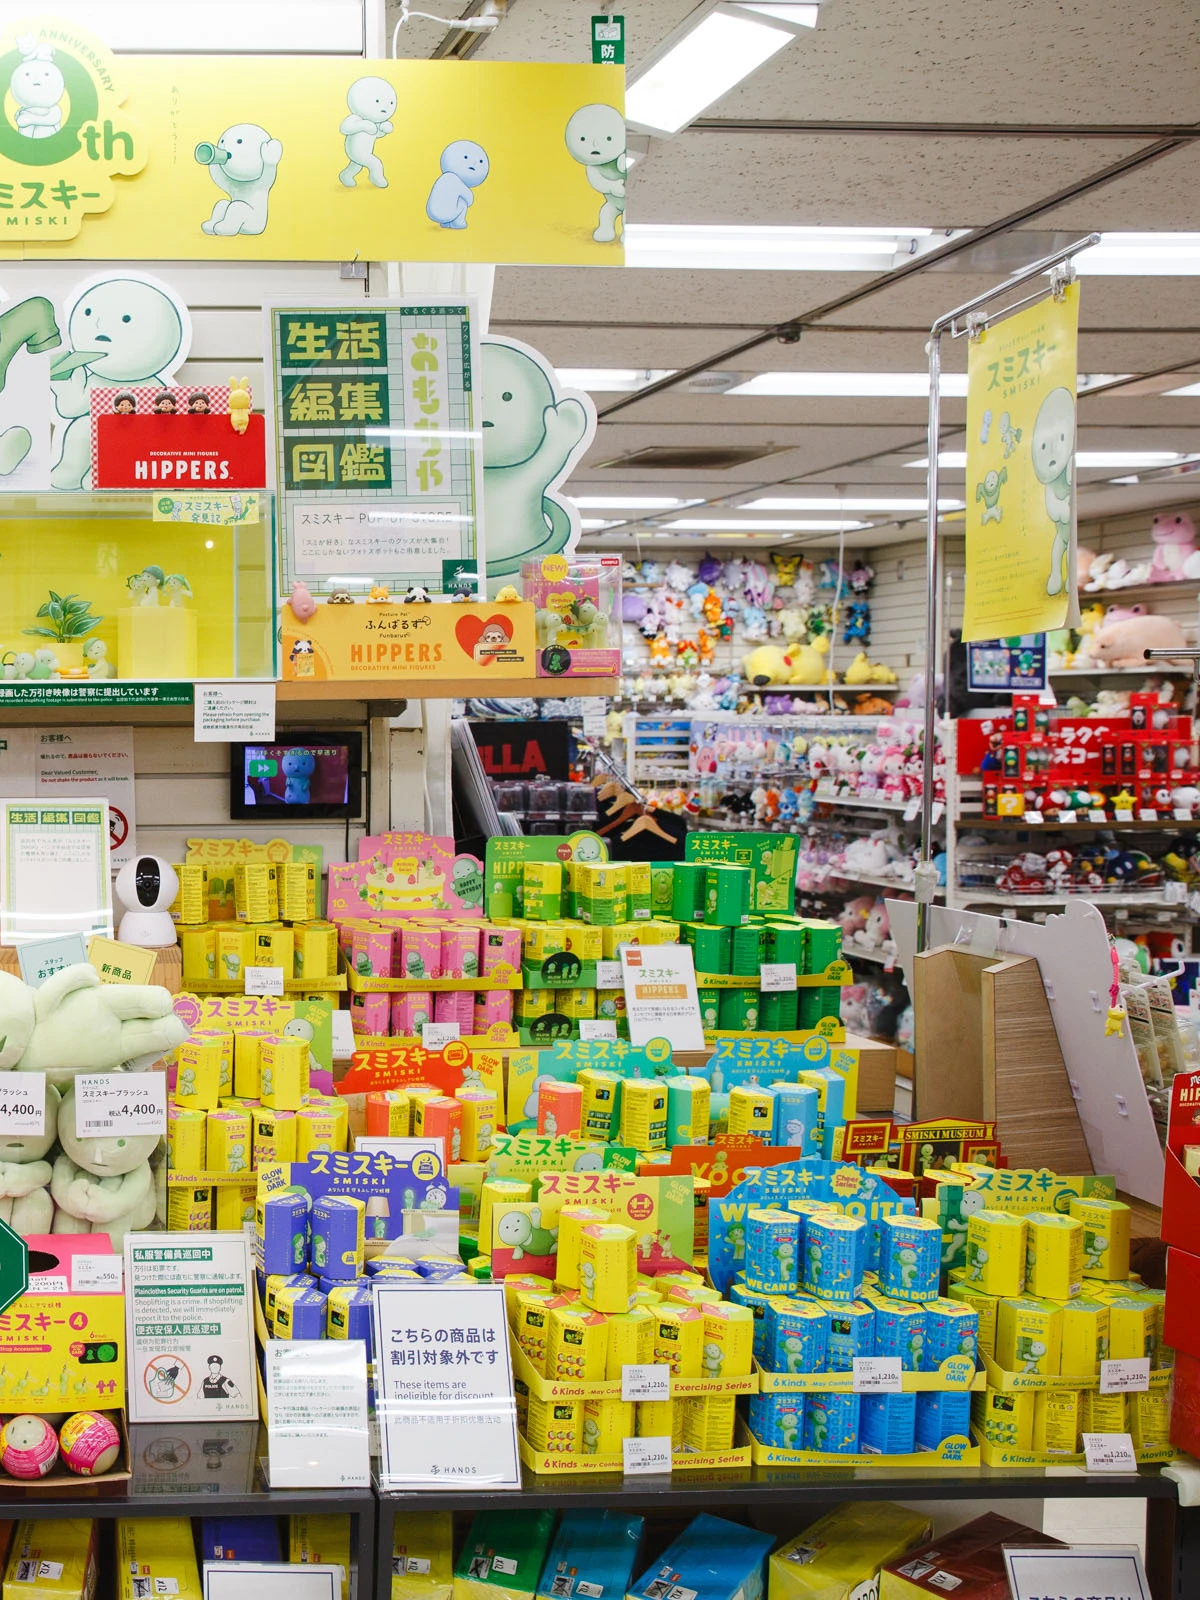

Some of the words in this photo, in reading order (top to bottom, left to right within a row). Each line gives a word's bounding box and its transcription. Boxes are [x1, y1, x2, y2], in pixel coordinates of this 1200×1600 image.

[38, 28, 115, 93] ANNIVERSARY
[287, 322, 380, 360] 生活
[987, 340, 1056, 392] スミスキー
[1003, 376, 1041, 399] SMISKI
[289, 382, 383, 421] 編集
[292, 444, 386, 482] 図鑑
[135, 460, 229, 480] HIPPERS
[351, 643, 442, 662] HIPPERS
[457, 884, 484, 897] BIRTHDAY
[460, 880, 476, 890] HAPPY
[102, 964, 132, 980] 新商品
[354, 1050, 440, 1071] スミスキー
[480, 1054, 500, 1068] GLOW
[905, 1129, 941, 1140] SMISKI
[943, 1128, 985, 1139] MUSEUM
[835, 1181, 858, 1189] Series
[836, 1175, 858, 1185] Cheer
[134, 1249, 211, 1260] 私服警備員巡回中
[226, 1286, 243, 1294] patrol.
[136, 1324, 219, 1335] 便衣安保人员巡逻中
[391, 1328, 497, 1344] こちらの商品は
[390, 1350, 499, 1366] 割引対象外です
[946, 1373, 966, 1382] DARK
[394, 1380, 417, 1390] These
[420, 1380, 448, 1390] items
[450, 1382, 466, 1390] are
[552, 1386, 558, 1395] 6
[559, 1387, 585, 1396] Kinds
[674, 1383, 723, 1392] Exercising
[725, 1381, 752, 1390] Series
[944, 1442, 966, 1451] GLOW
[942, 1452, 962, 1460] DARK
[1141, 1449, 1174, 1460] Moving
[544, 1459, 550, 1467] 6
[552, 1460, 578, 1468] Kinds
